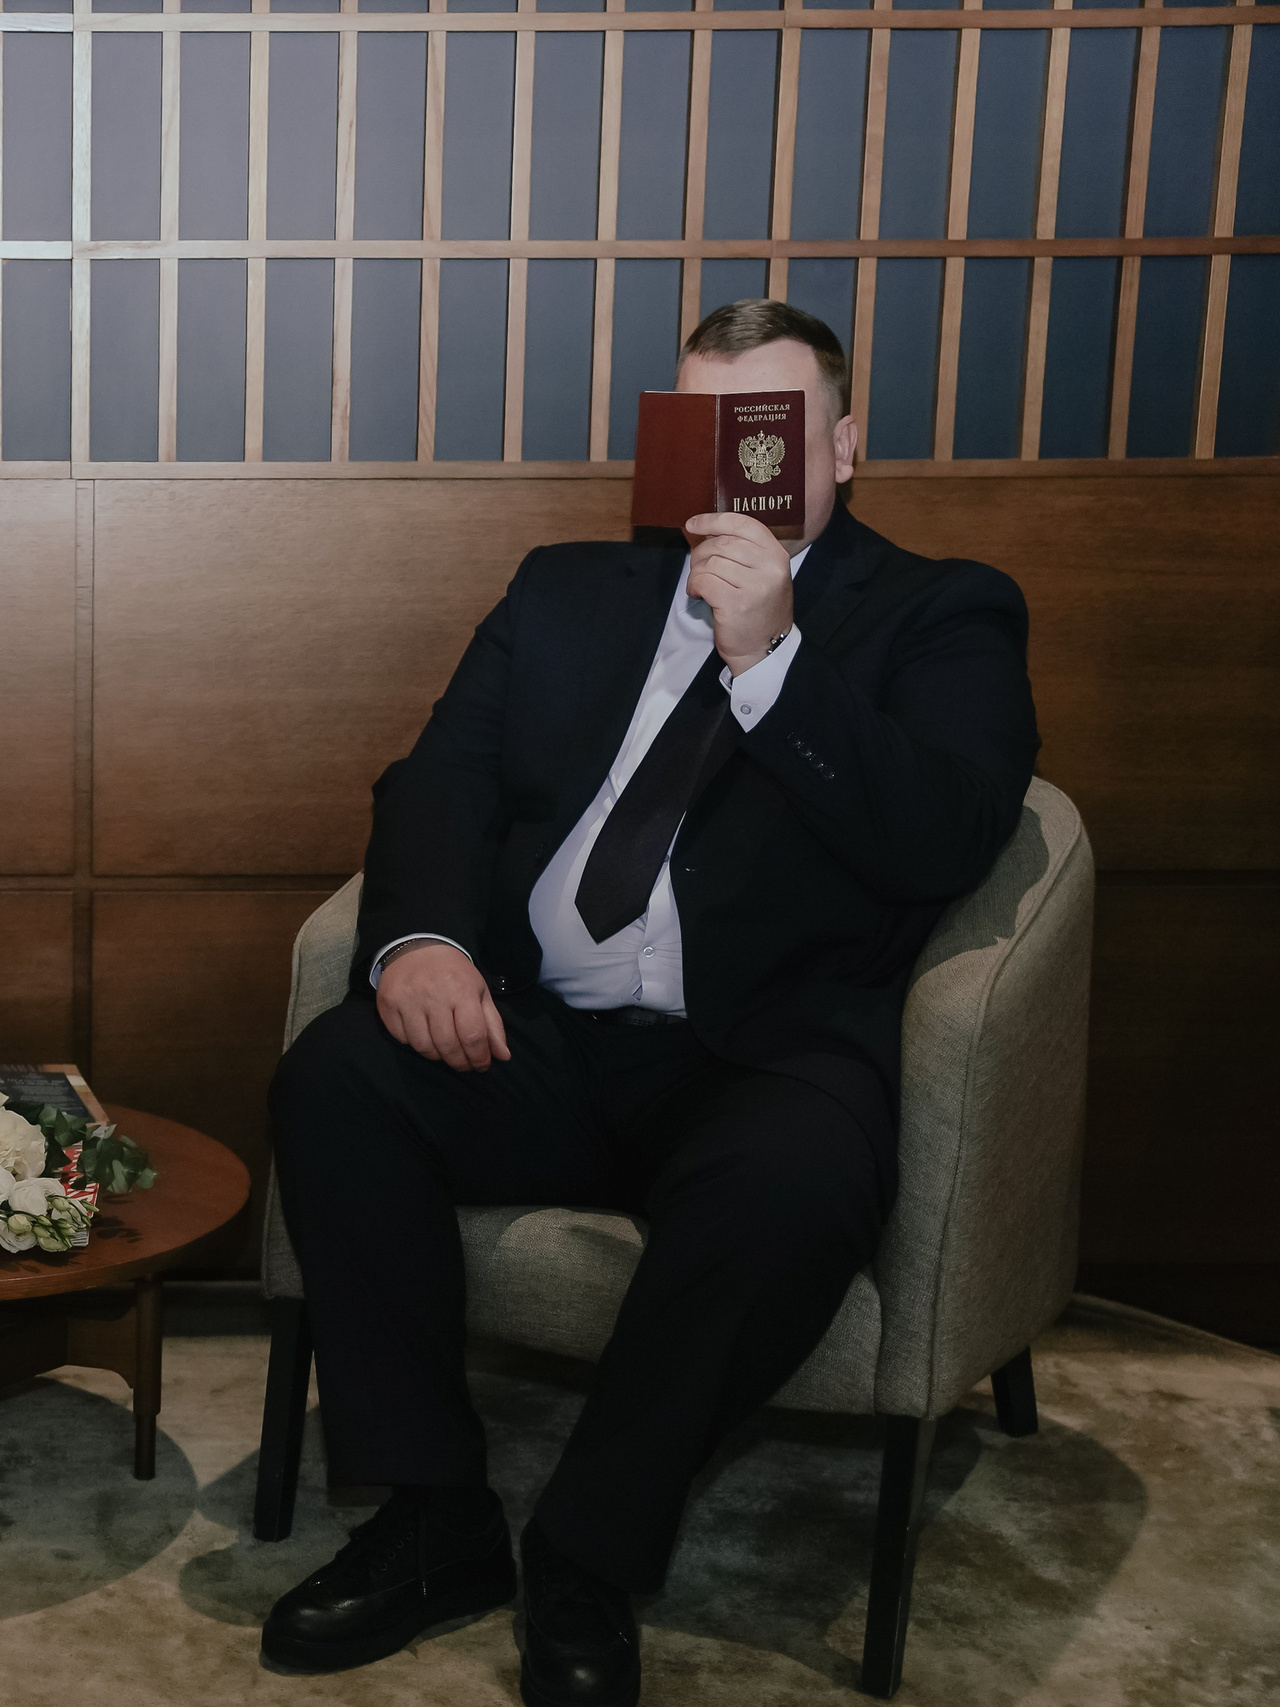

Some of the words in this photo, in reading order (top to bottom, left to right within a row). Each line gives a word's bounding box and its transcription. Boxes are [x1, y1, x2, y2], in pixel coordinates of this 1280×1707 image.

[734, 403, 791, 413] РОССИЙСКАЯ
[737, 413, 787, 423] ФЕДЕРАЦИЯ
[733, 494, 793, 512] ПАСПОРТ
